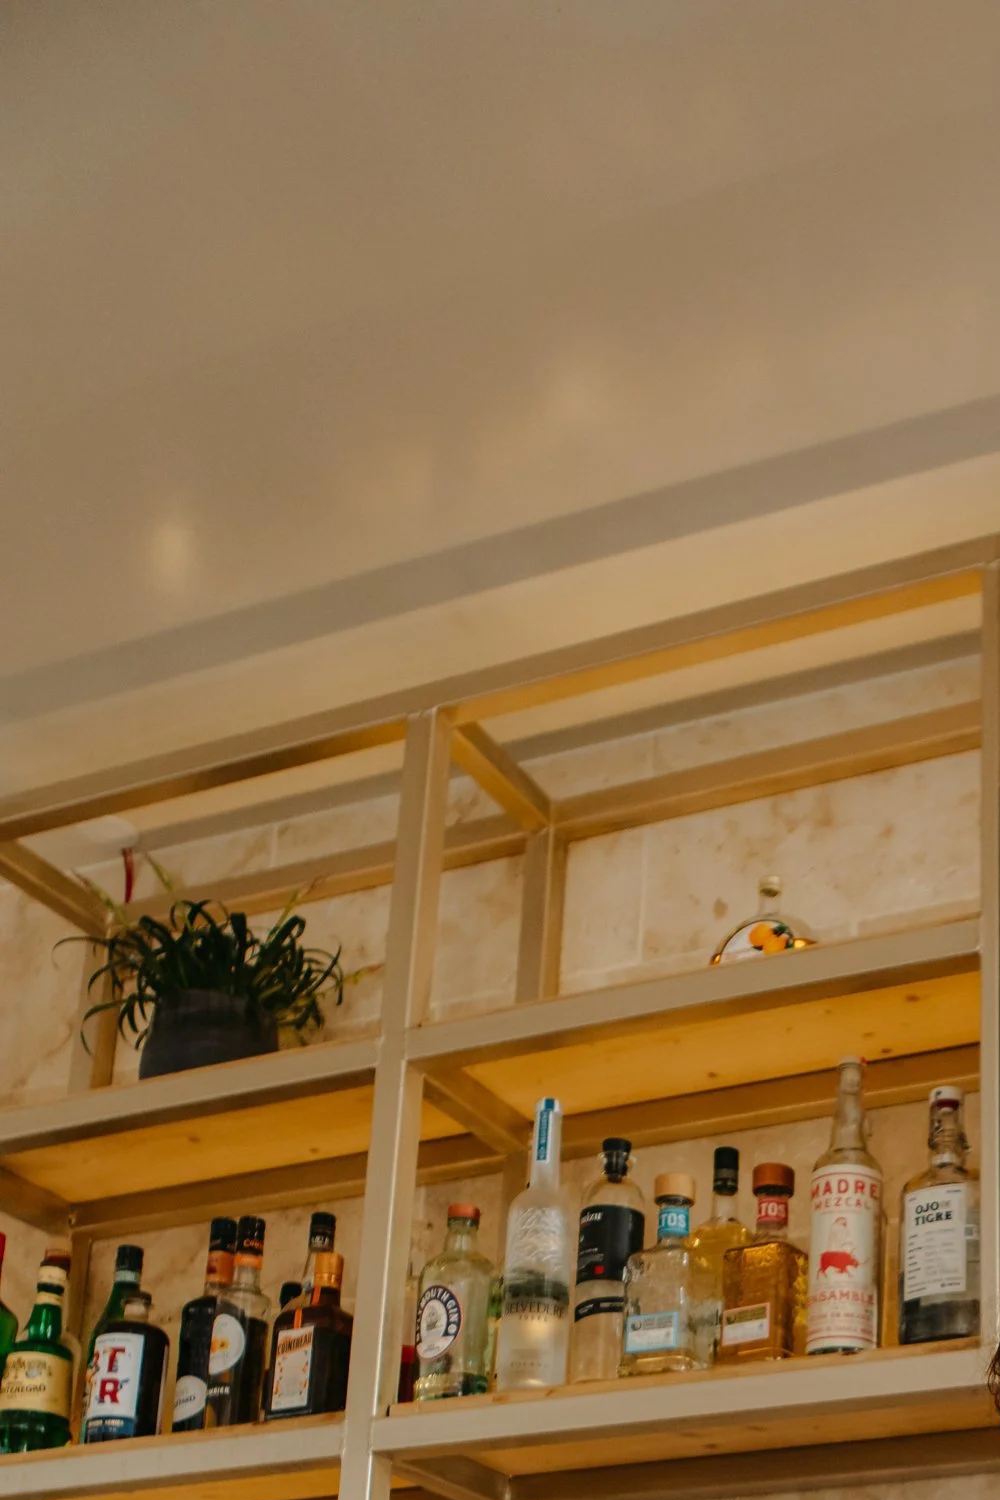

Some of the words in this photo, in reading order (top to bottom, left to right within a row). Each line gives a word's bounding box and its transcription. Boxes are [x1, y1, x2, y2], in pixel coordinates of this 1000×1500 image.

[811, 1179, 878, 1199] MADRE
[815, 1197, 870, 1211] MEZCAL
[915, 1201, 939, 1214] OJO
[915, 1211, 952, 1225] TIGRE
[277, 1333, 312, 1355] COINTREAU
